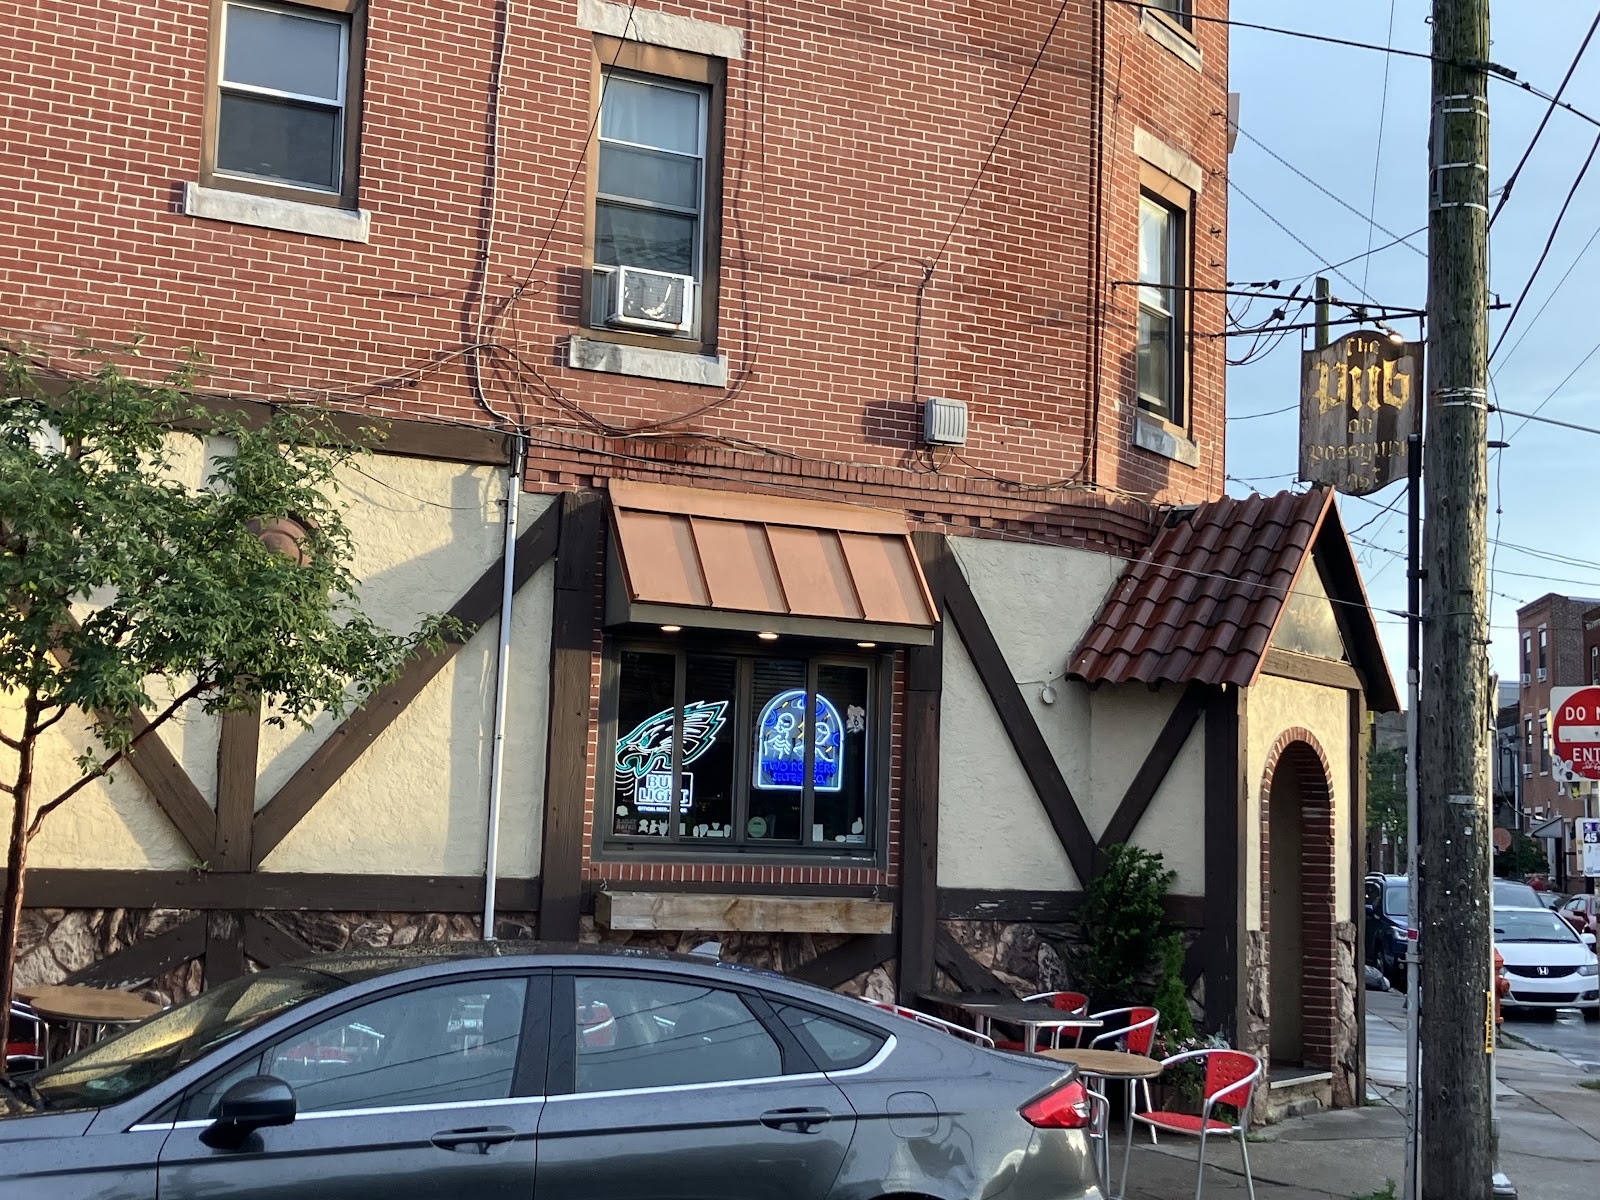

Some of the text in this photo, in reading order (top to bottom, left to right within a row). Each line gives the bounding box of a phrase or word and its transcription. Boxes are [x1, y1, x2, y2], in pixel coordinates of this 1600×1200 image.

[1346, 337, 1381, 356] The
[1312, 358, 1411, 415] Pub
[1348, 418, 1373, 434] on
[1565, 706, 1586, 721] DO
[761, 761, 837, 774] TWO ROBERS
[646, 774, 672, 788] BU
[772, 772, 805, 783] SELTZE
[1584, 832, 1598, 843] 45
